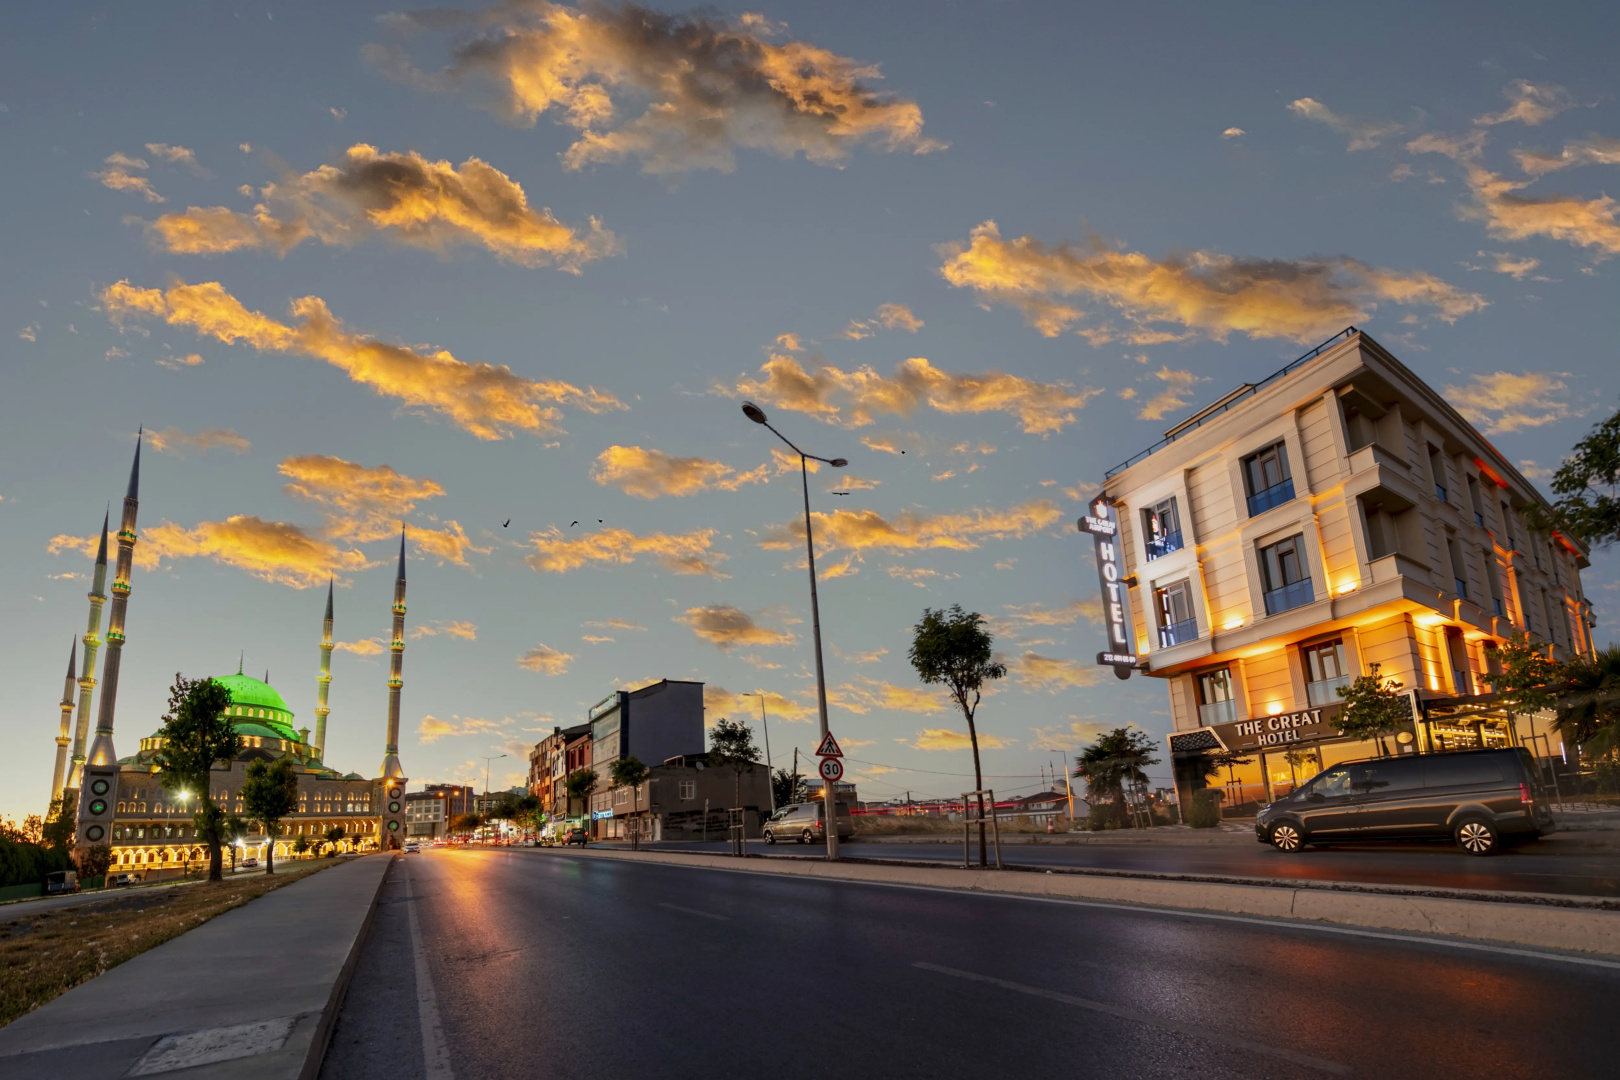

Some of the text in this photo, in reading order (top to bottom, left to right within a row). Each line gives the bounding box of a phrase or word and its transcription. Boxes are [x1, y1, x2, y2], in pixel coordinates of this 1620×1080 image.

[1085, 516, 1097, 525] THE
[1100, 542, 1126, 643] HOTEL
[1235, 709, 1321, 736] THE GREAT
[1258, 729, 1301, 746] HOTEL
[824, 763, 839, 775] 30
